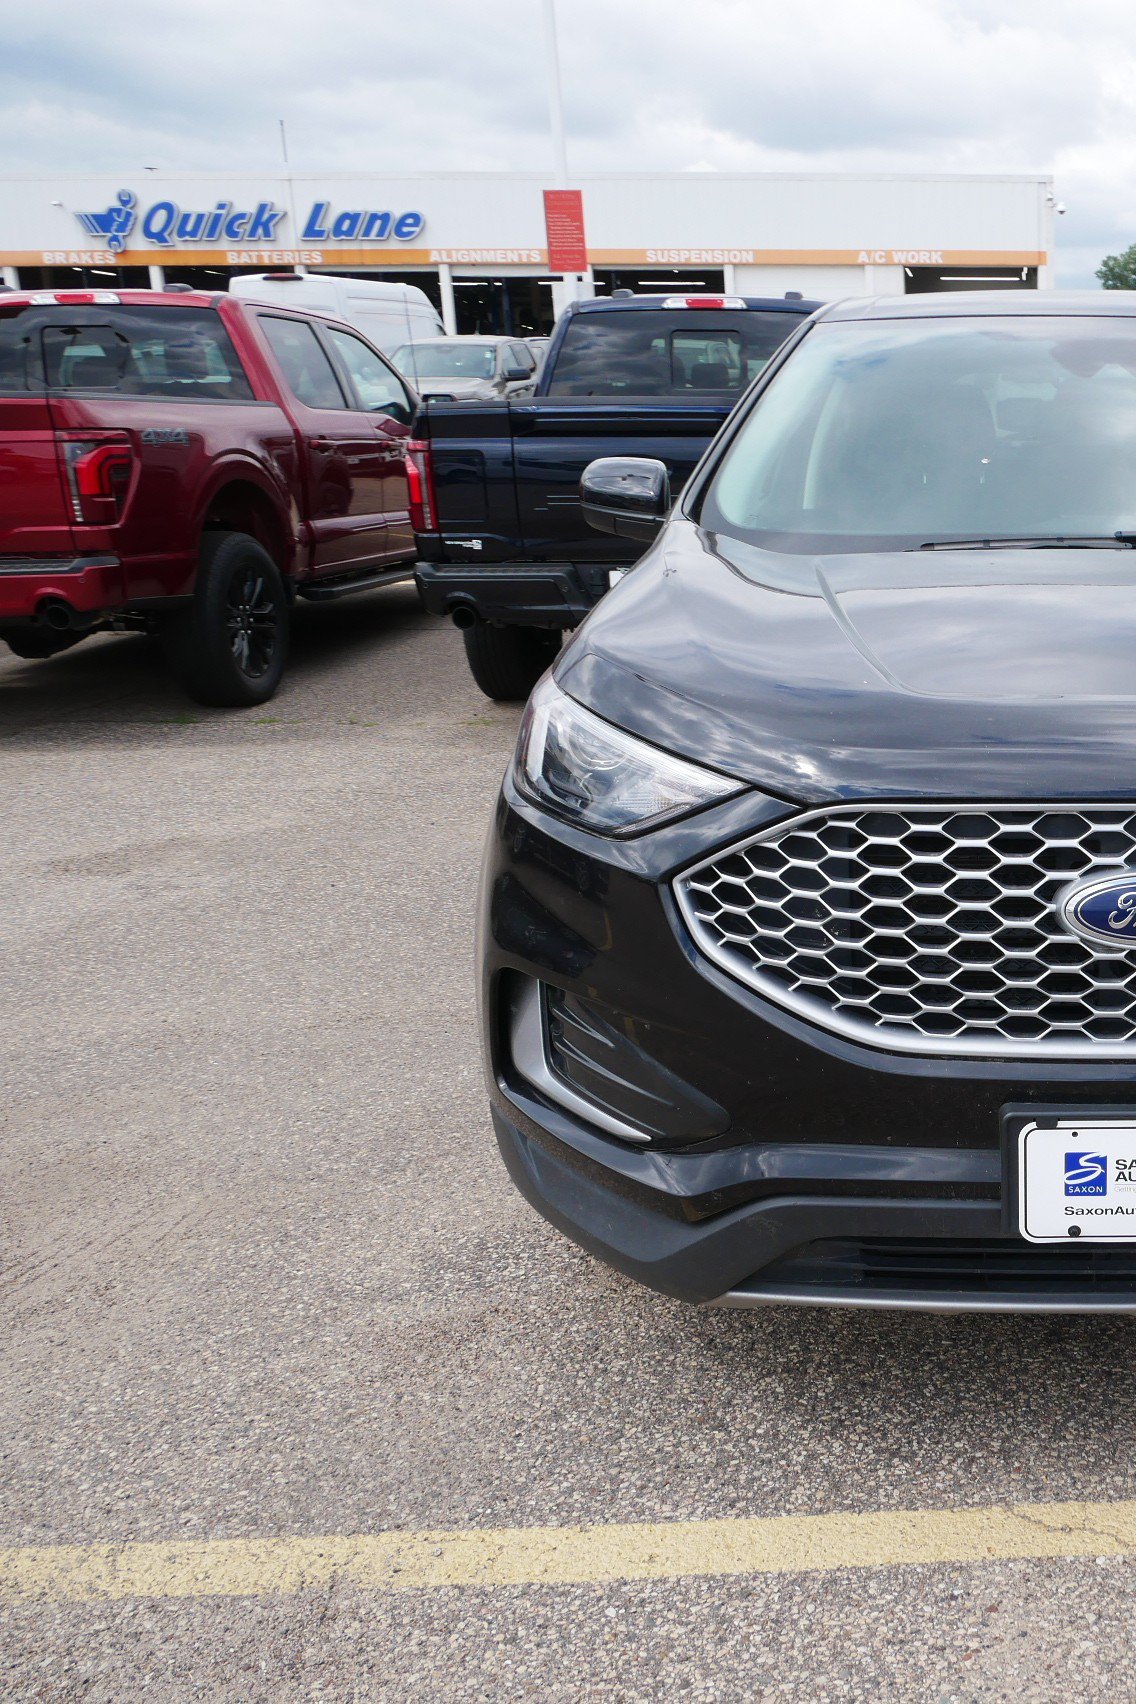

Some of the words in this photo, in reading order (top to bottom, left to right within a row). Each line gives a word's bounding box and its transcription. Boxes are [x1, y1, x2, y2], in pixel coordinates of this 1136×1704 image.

[142, 200, 287, 247] Quick
[300, 200, 425, 241] Lane
[42, 252, 117, 265] BRAKES
[226, 251, 324, 264] BATTERIES
[429, 249, 542, 263] ALIGNMENTS
[645, 250, 754, 263] SUSPENSION
[857, 251, 887, 263] A/C
[892, 251, 943, 263] WORK
[1068, 1186, 1103, 1194] SAXON
